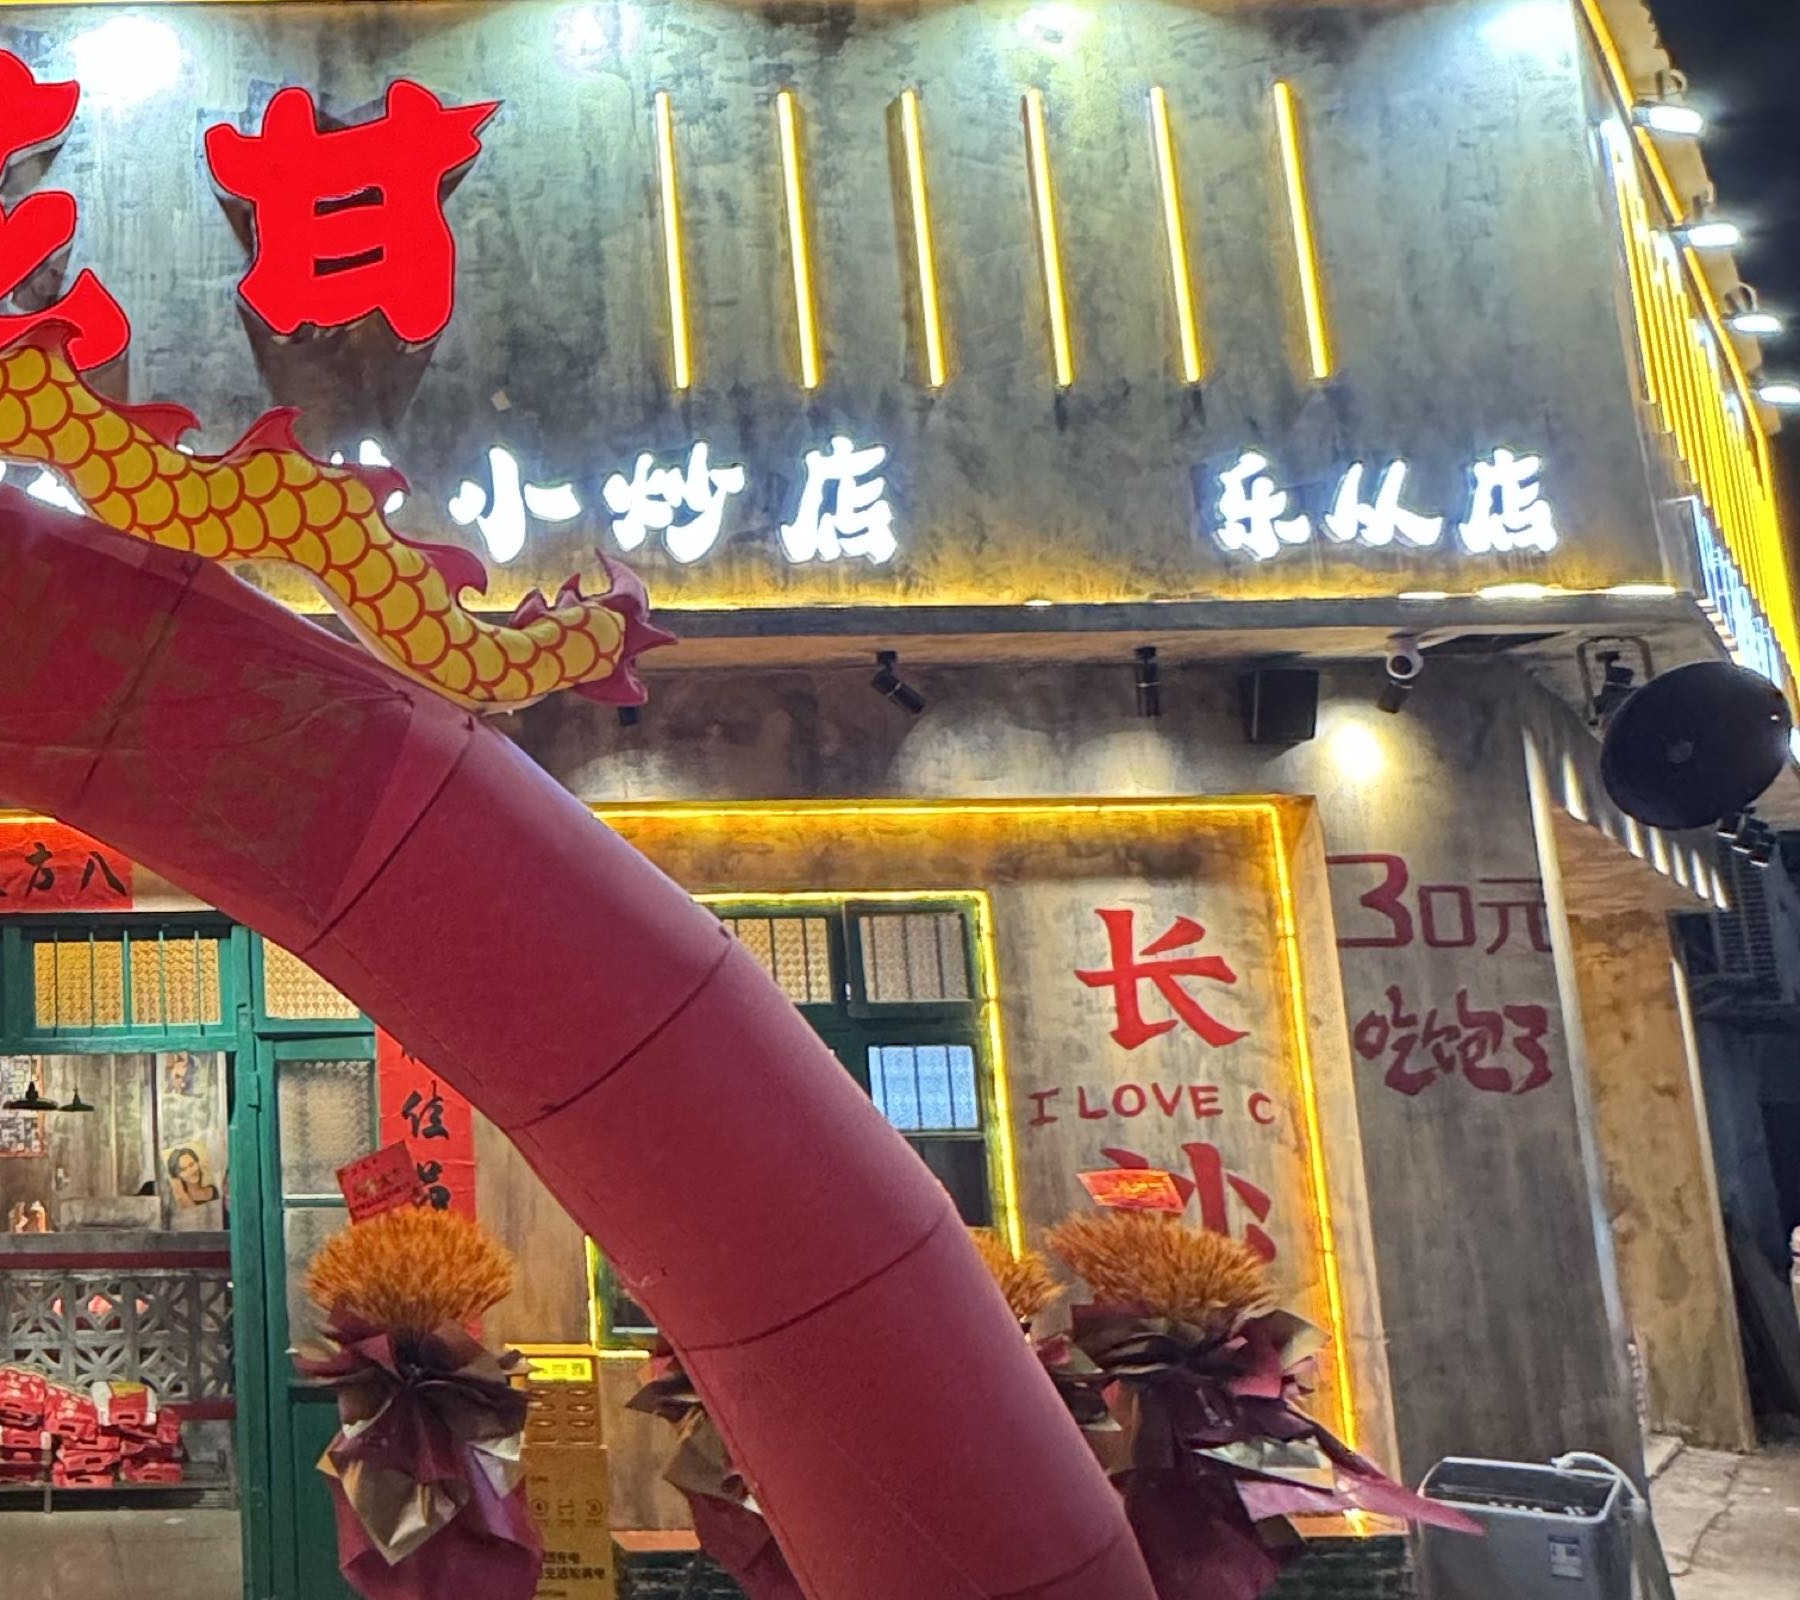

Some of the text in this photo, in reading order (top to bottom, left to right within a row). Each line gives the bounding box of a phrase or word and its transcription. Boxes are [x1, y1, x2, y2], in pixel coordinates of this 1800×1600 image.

[330, 435, 902, 565] 小炒店
[1213, 450, 1558, 561] 乐从店
[1325, 853, 1552, 955] 30元
[1074, 908, 1250, 1050] 长
[1028, 1087, 1062, 1127] I
[1077, 1083, 1224, 1121] LOVE
